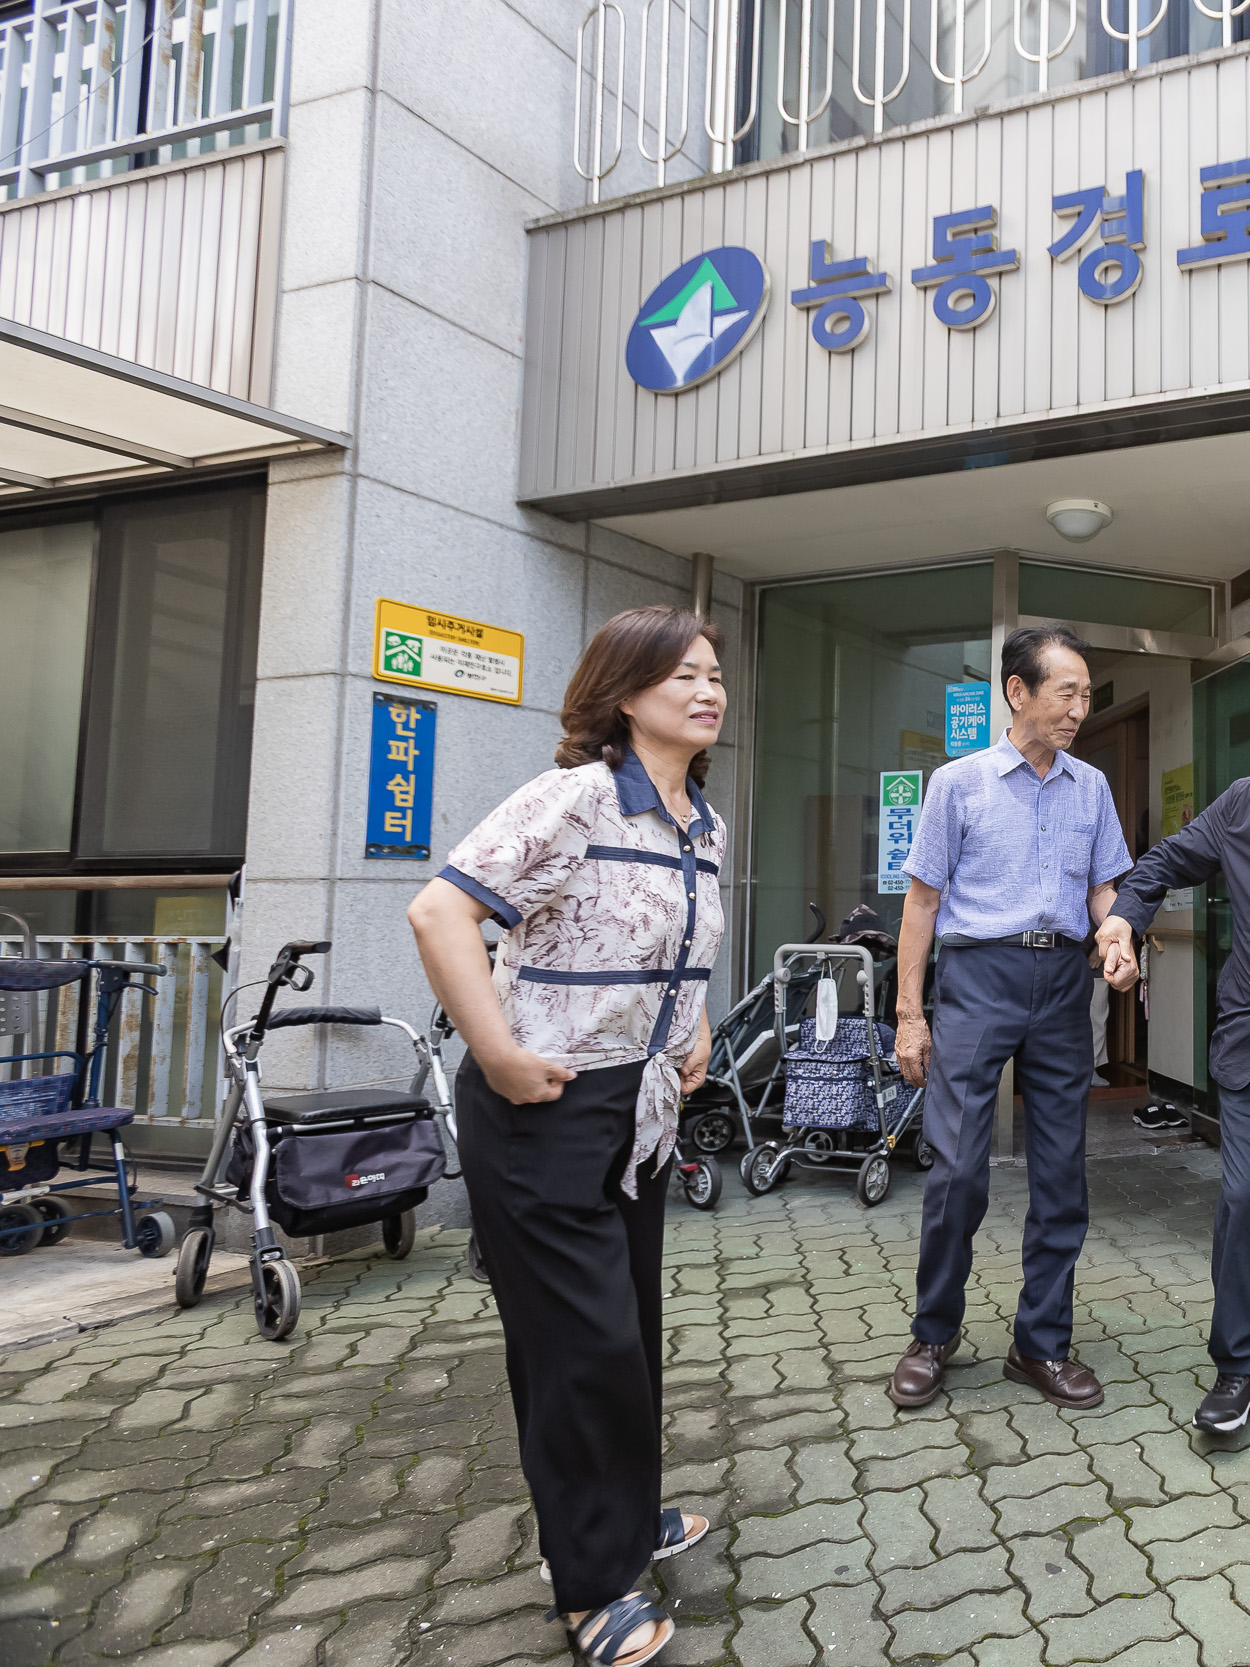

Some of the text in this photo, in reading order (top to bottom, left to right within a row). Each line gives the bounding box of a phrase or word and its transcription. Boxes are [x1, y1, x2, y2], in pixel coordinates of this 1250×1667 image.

[950, 702, 986, 716] 바이러스
[950, 714, 986, 728] 공기케어
[950, 728, 976, 740] 시스템
[384, 703, 422, 842] 한파쉼터
[886, 808, 914, 844] 무더위
